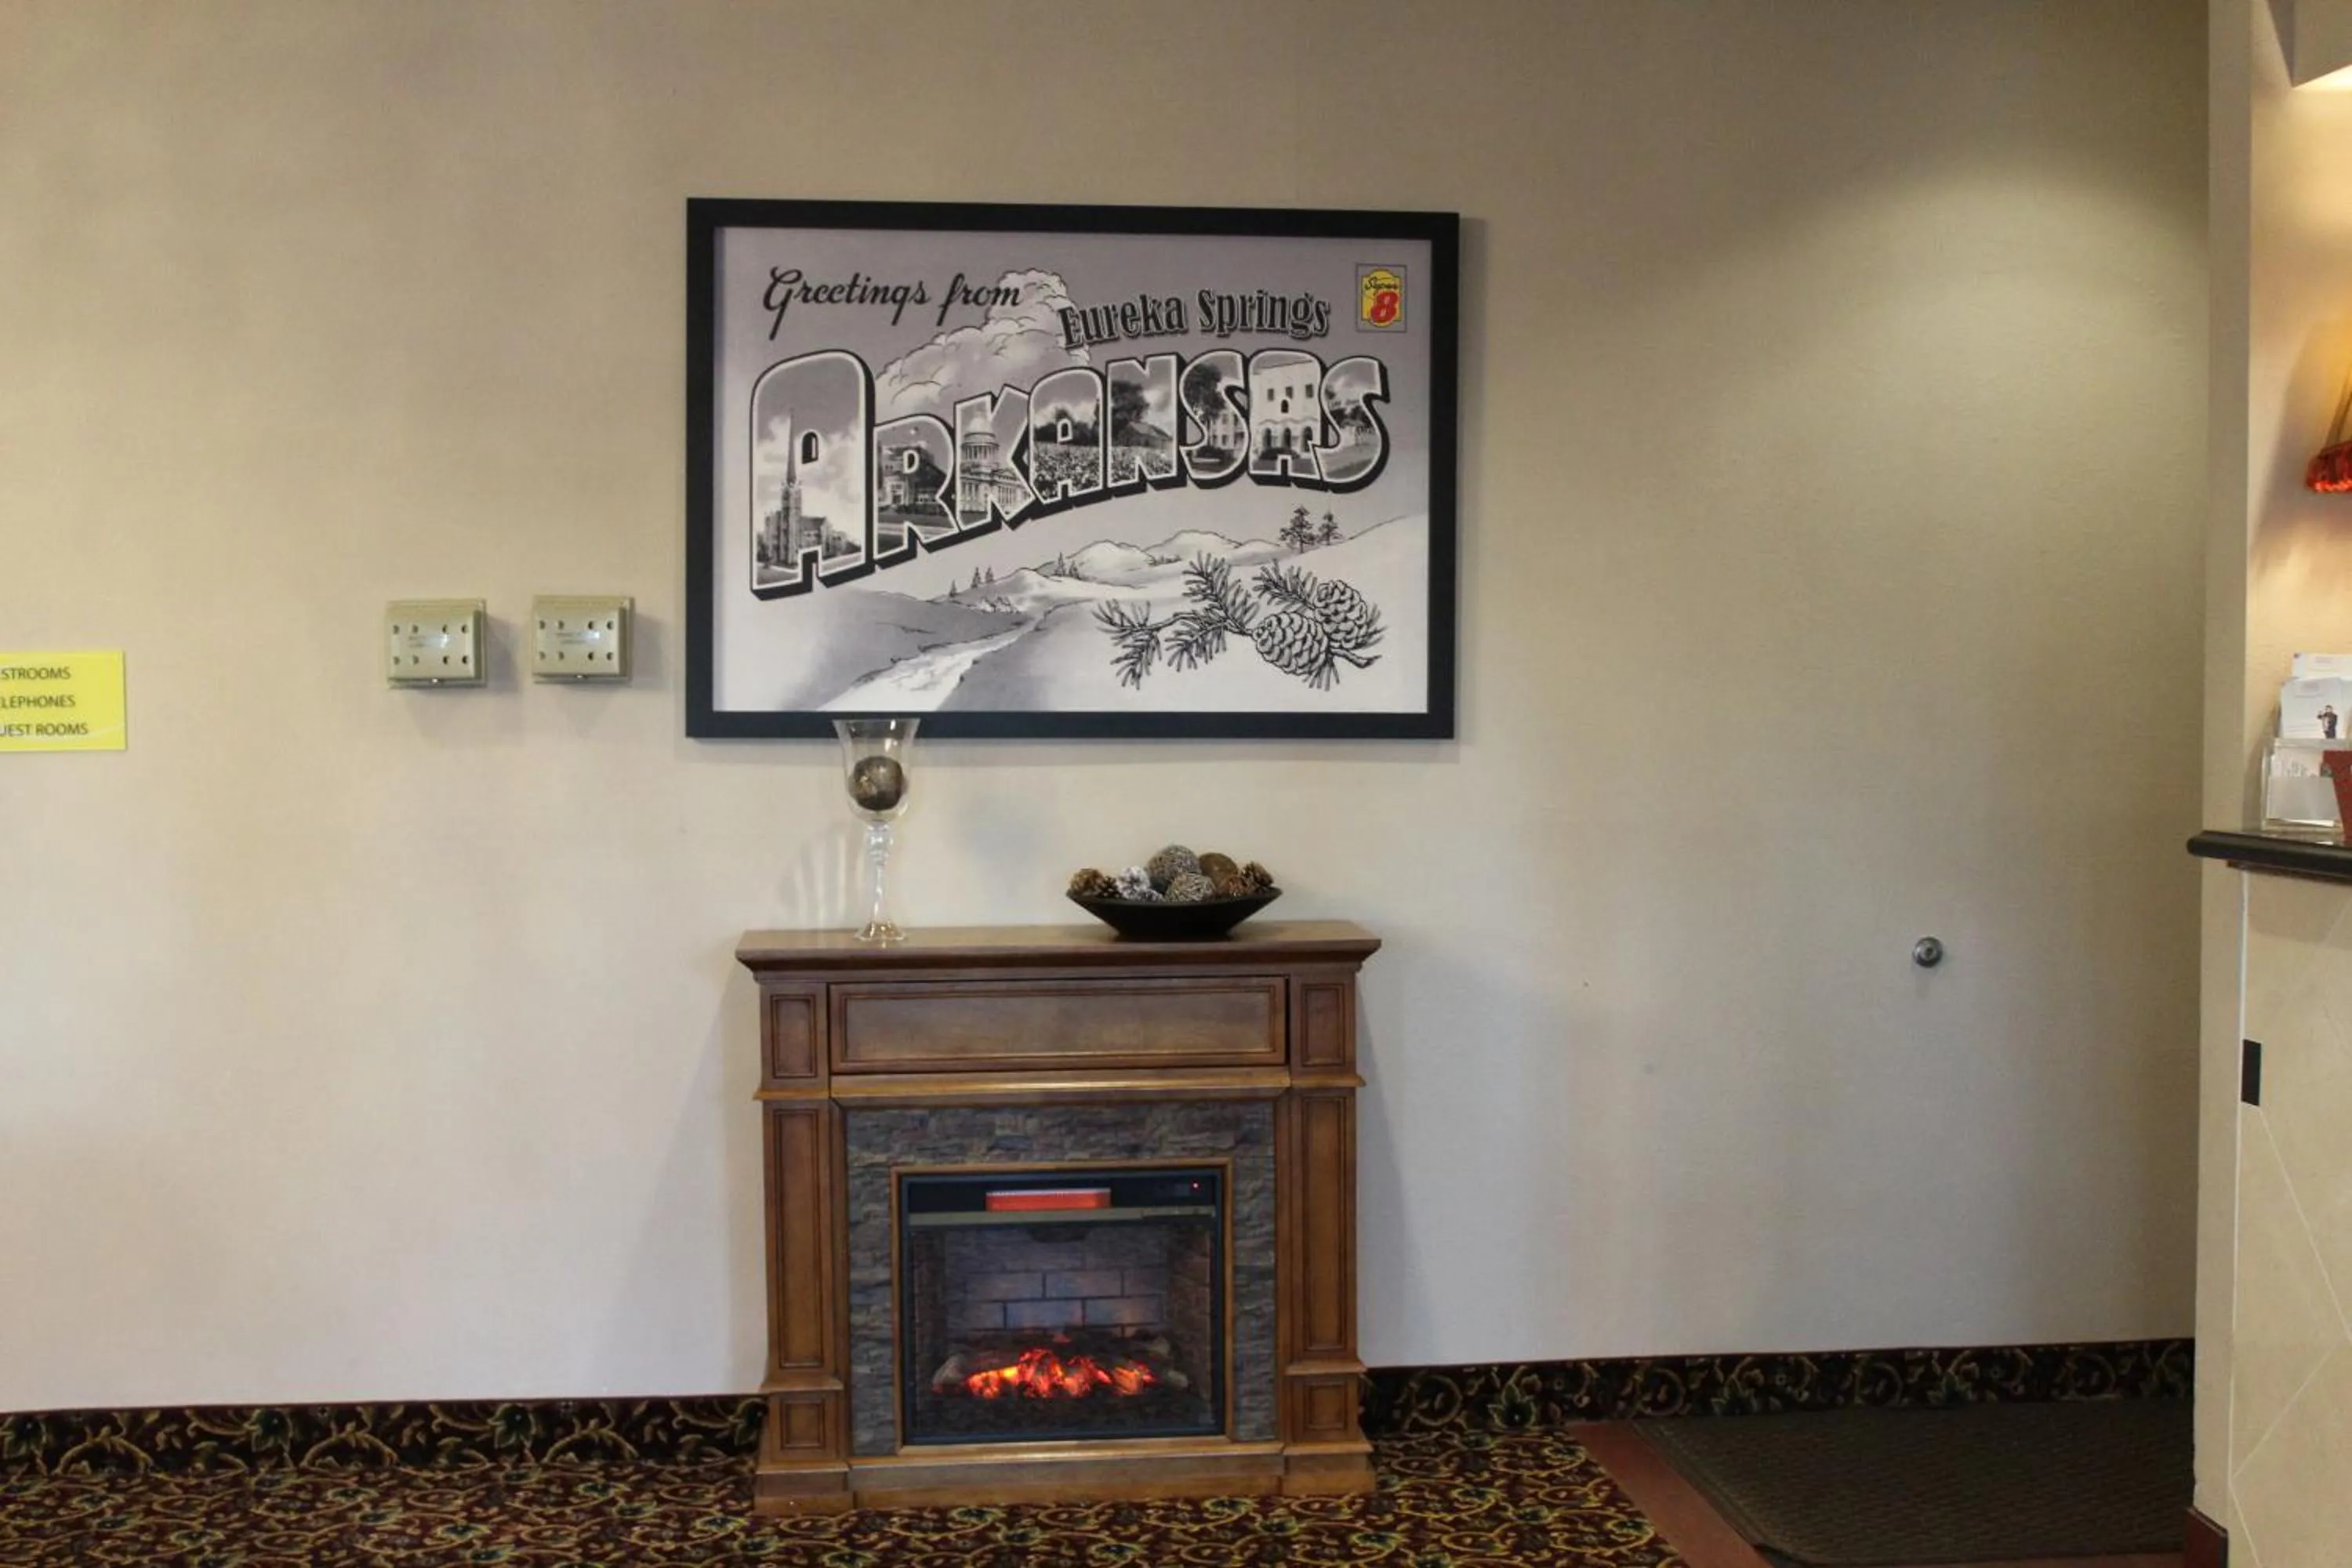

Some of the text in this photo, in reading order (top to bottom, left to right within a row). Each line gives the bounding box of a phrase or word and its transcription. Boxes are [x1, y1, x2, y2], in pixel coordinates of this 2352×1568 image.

[763, 266, 1022, 341] Greetings from
[1058, 294, 1189, 350] Eureka
[1370, 290, 1399, 323] 8
[750, 349, 1390, 599] ARKANSAS
[35, 722, 88, 736] ROOMS
